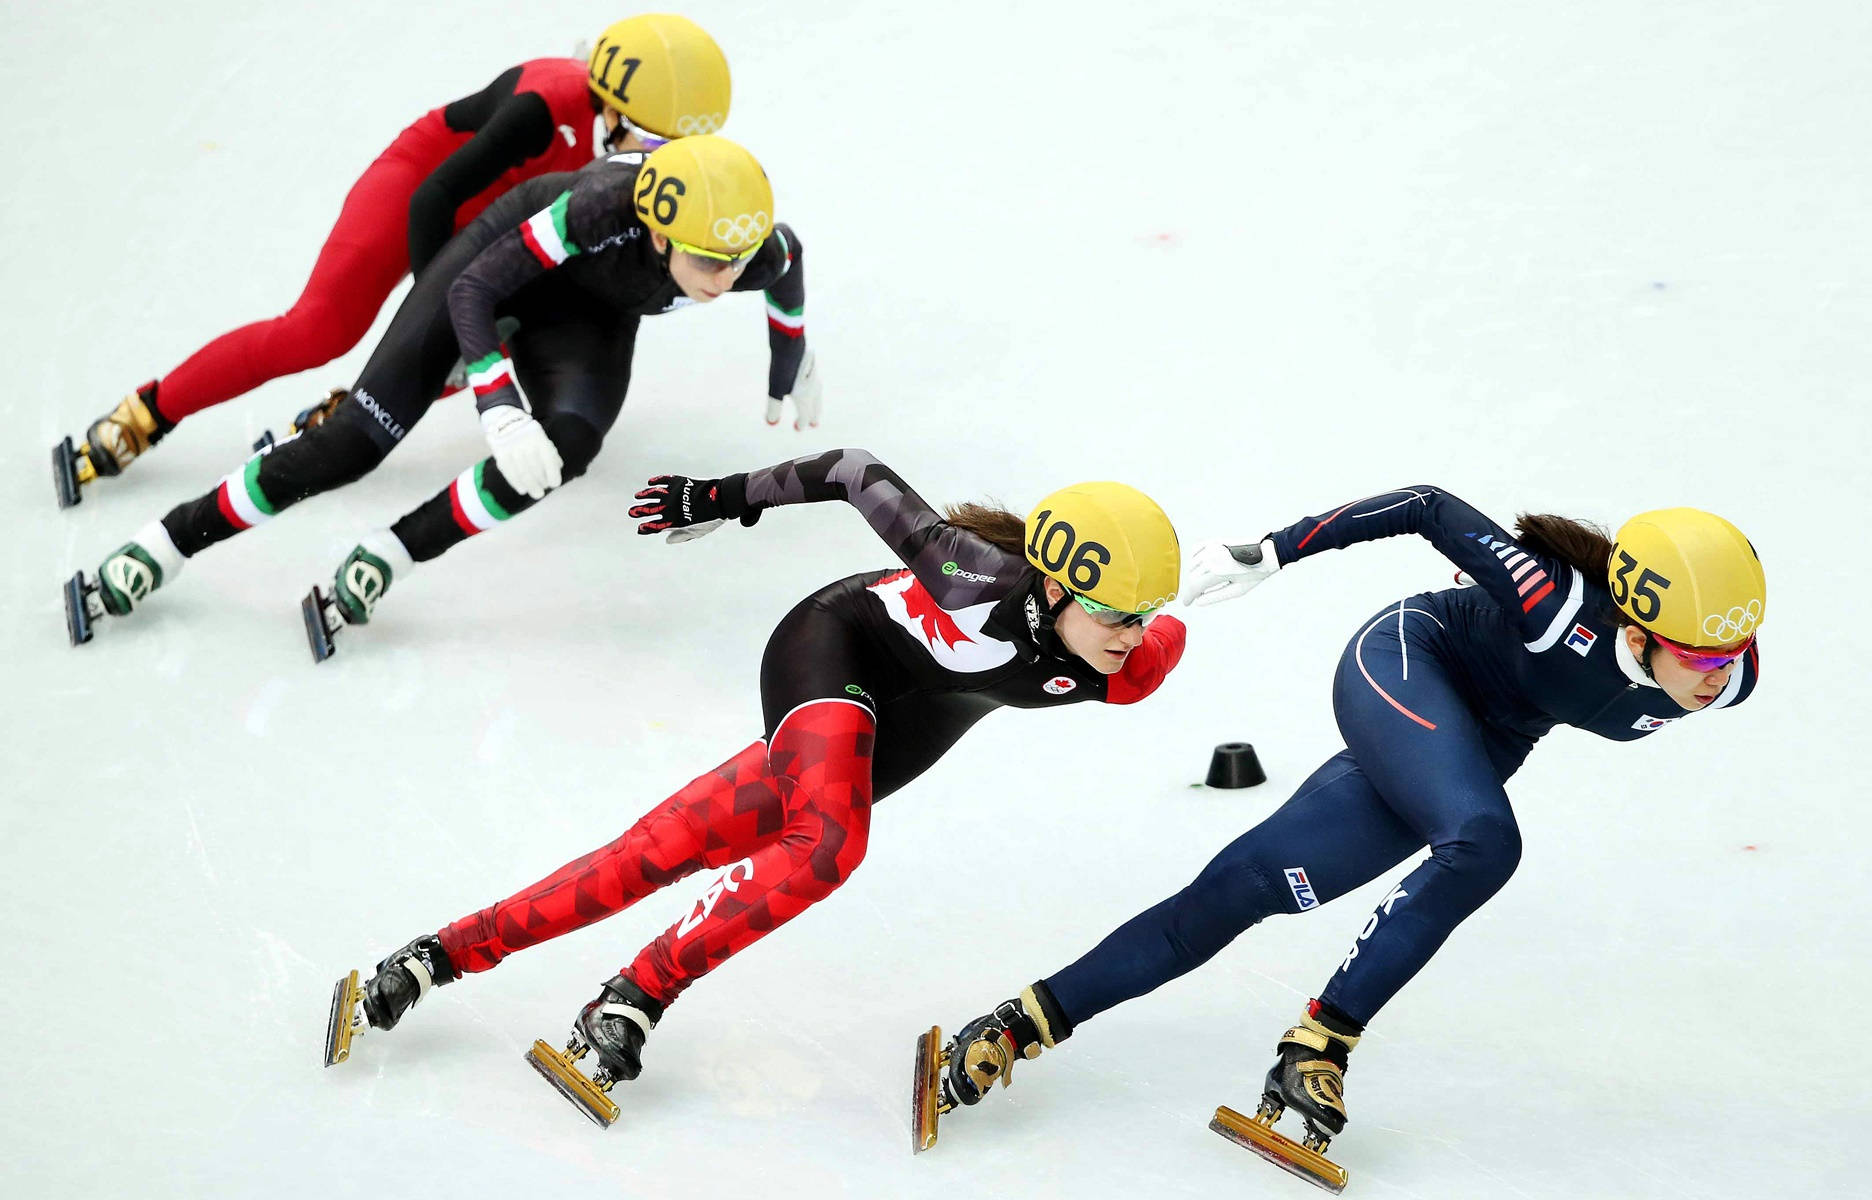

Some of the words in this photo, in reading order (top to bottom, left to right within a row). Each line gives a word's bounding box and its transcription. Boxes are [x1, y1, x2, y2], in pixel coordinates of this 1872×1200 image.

[590, 36, 641, 103] 111
[637, 167, 686, 226] 26
[682, 478, 694, 522] Auclair
[1027, 509, 1111, 591] 106
[1609, 542, 1671, 622] 35
[676, 857, 754, 939] CAN
[1288, 871, 1315, 907] FILA
[1342, 882, 1409, 973] KOR
